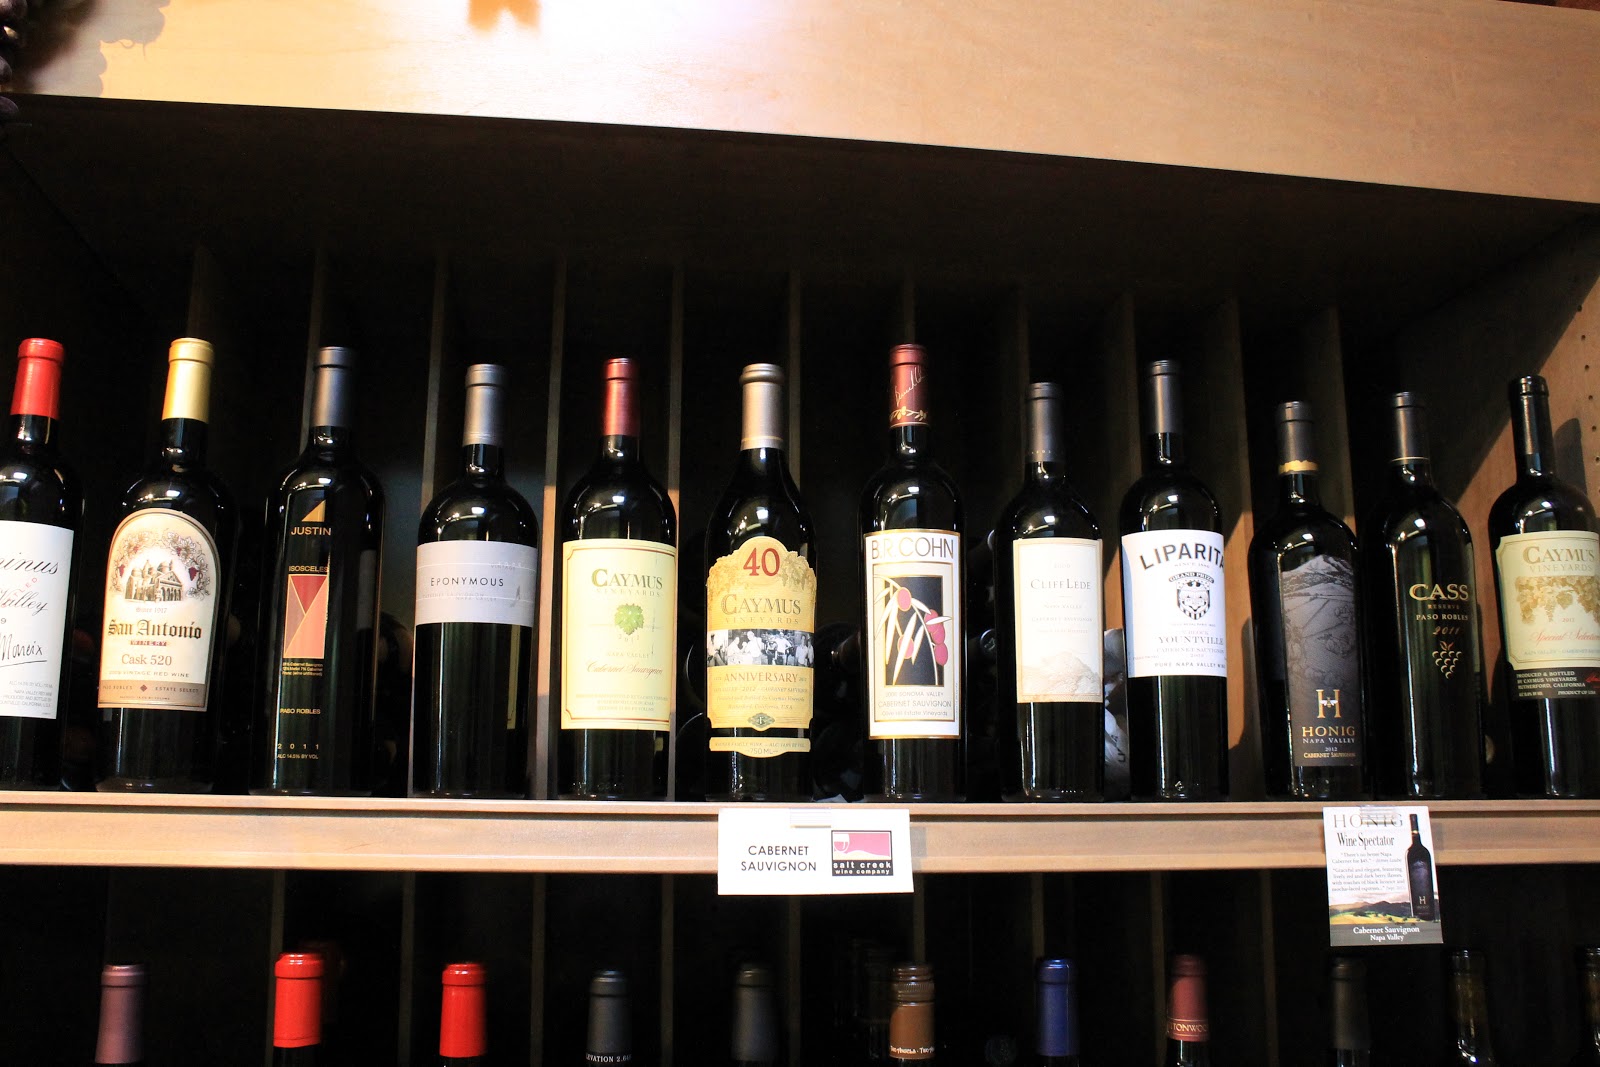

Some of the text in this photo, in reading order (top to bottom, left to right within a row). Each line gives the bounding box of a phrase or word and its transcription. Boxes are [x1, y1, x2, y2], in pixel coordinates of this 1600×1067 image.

[290, 526, 332, 536] JUSTIN
[899, 536, 954, 559] COHN
[1522, 545, 1596, 565] CAYMUS
[743, 547, 780, 577] 40
[288, 565, 329, 573] ISOSCELES
[1529, 563, 1593, 573] VINEYARDS
[430, 577, 504, 588] EPONYMOUS
[591, 568, 663, 590] CAYMUS
[1030, 578, 1091, 590] CLIFF LEDE
[596, 588, 661, 597] VINEYARDS
[1409, 583, 1469, 601] CASS
[721, 593, 802, 615] CAYMUS
[725, 616, 800, 625] VINEYARDS
[108, 619, 202, 640] San Antonio
[1158, 635, 1224, 646] YOUNTVILLE
[121, 653, 172, 666] Cask 520
[723, 671, 798, 683] ANNIVERSARY
[878, 700, 952, 708] CABERNET SAUVIGNON
[922, 710, 948, 718] Vineyards
[1301, 725, 1355, 737] HONIG
[1333, 813, 1403, 829] HONIG
[1337, 831, 1395, 850] Wine Spectator
[747, 845, 809, 856] CABERNET
[740, 861, 817, 872] SAUVIGNON
[833, 860, 892, 869] salt creek
[1352, 925, 1420, 936] Cabernet Sauvignon
[1370, 934, 1404, 942] Napa Valley
